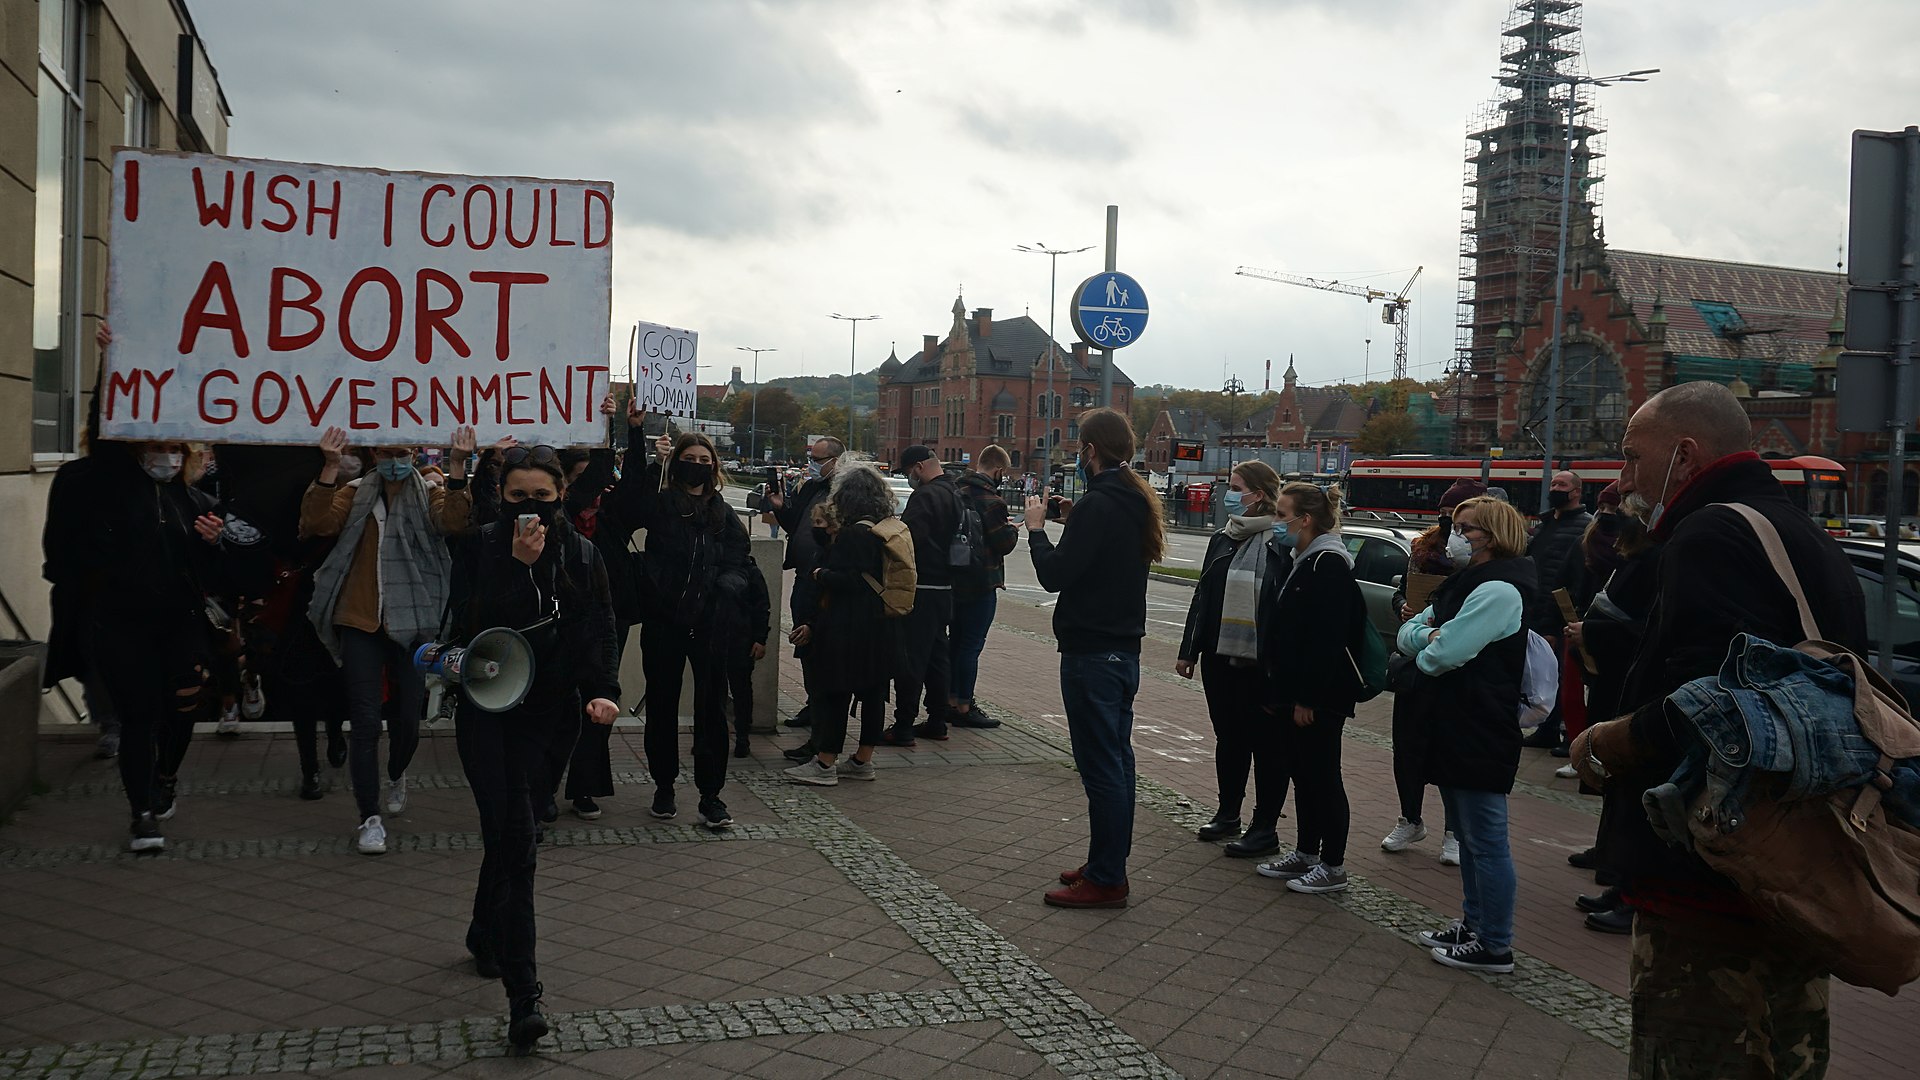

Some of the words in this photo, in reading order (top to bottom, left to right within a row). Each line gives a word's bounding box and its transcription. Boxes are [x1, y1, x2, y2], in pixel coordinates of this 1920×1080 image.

[124, 160, 139, 221] I
[192, 167, 341, 239] WISH
[383, 183, 395, 247] I
[420, 184, 612, 250] COULD
[178, 261, 549, 364] ABORT
[643, 331, 695, 364] GOD
[106, 368, 174, 423] MY
[198, 365, 608, 429] GOVERNMENT
[642, 380, 694, 409] WOMAN
[650, 362, 663, 381] IS
[670, 366, 683, 384] A
